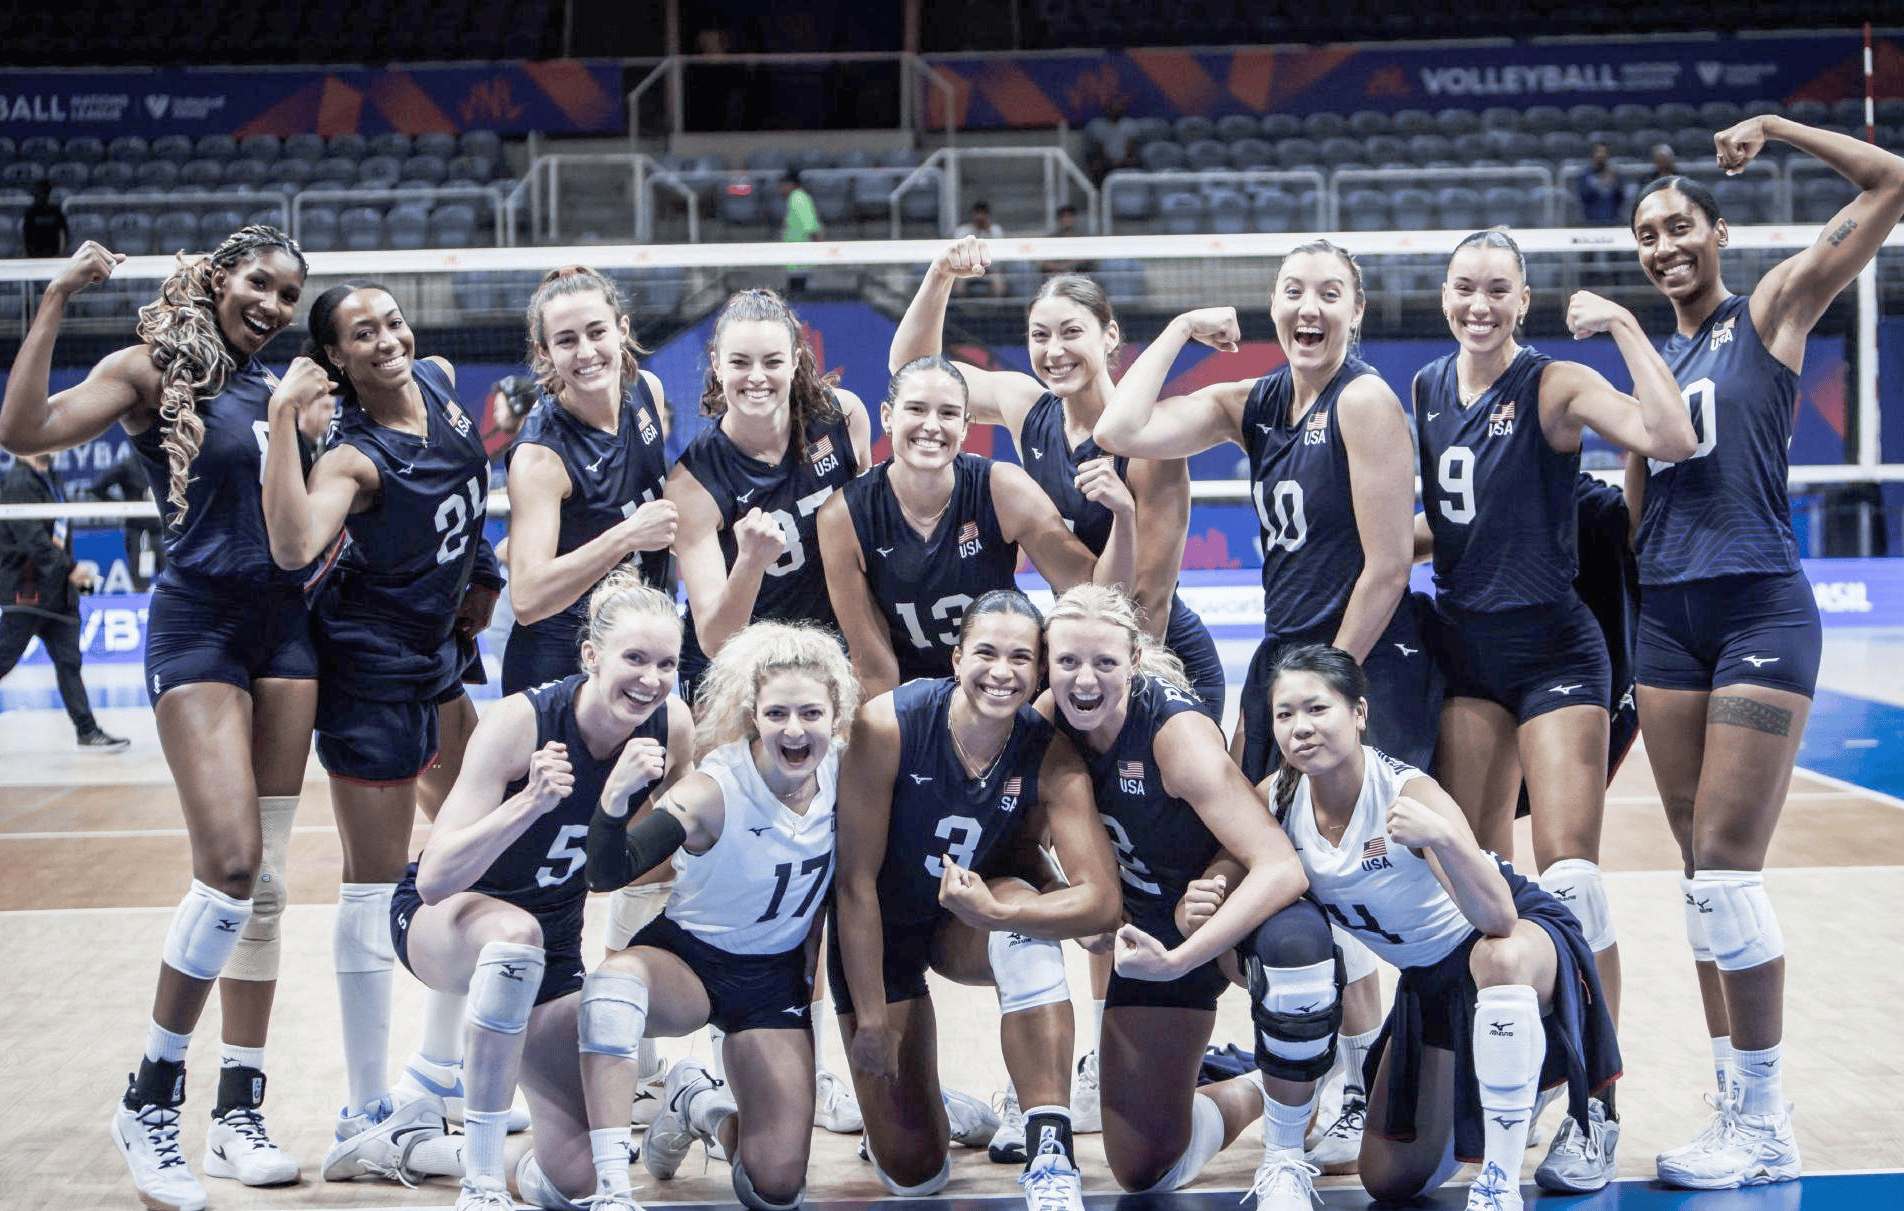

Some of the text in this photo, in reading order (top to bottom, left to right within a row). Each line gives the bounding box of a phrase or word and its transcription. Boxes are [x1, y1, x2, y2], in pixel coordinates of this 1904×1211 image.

[1420, 63, 1617, 95] VOLLEYBALL
[1710, 332, 1734, 352] USA
[455, 415, 473, 438] USA
[641, 423, 658, 445] USA
[1303, 428, 1327, 446] USA
[1488, 419, 1513, 438] USA
[813, 454, 839, 478] USA
[1438, 446, 1477, 525] 9
[1252, 480, 1308, 552] 10
[958, 538, 983, 559] USA
[1118, 778, 1146, 796] USA
[998, 795, 1018, 813] SA
[535, 824, 588, 888] 5
[924, 814, 983, 879] 3
[1361, 858, 1394, 873] USA
[756, 850, 837, 924] 17
